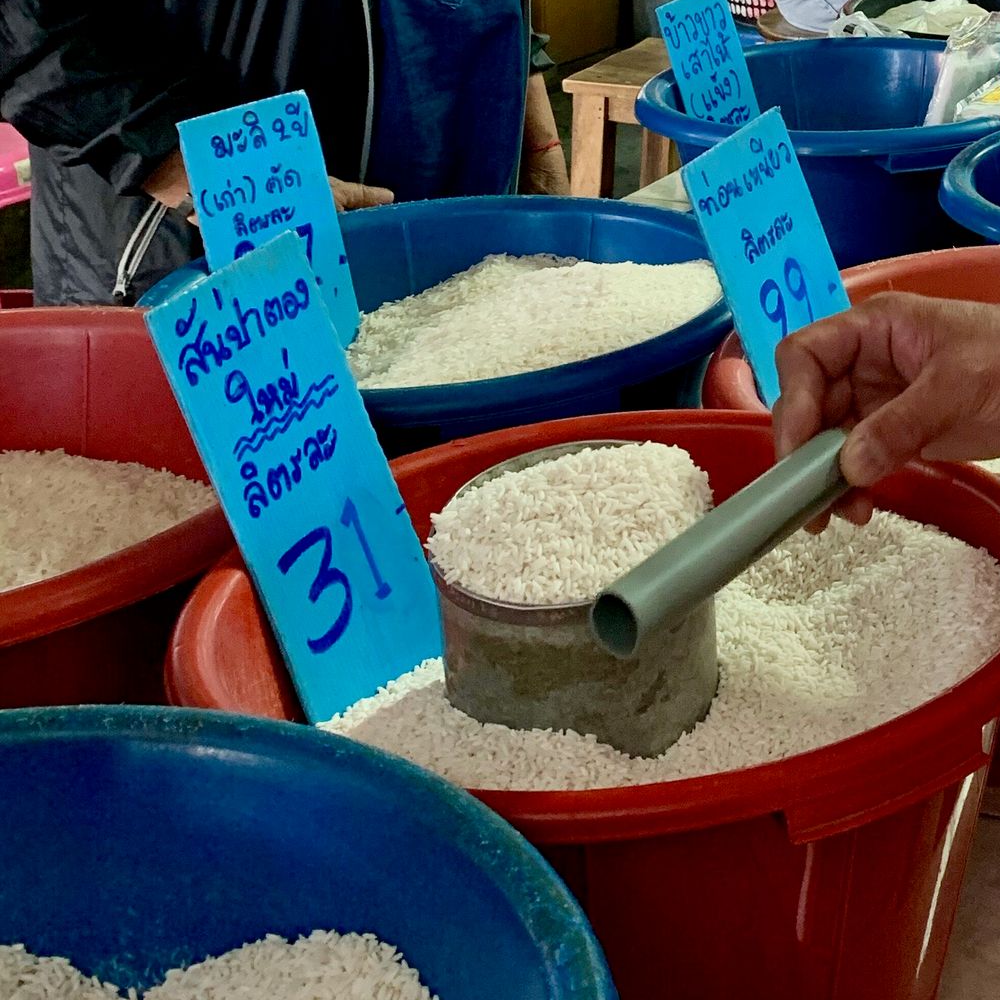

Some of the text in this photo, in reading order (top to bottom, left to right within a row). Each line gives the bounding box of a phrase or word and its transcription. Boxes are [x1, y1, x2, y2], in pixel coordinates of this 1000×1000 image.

[664, 2, 727, 50] ข้าวขาว
[211, 110, 267, 159] มะลิ
[200, 175, 256, 218] (เก่า)
[232, 206, 296, 237] ลิตรละ
[740, 212, 794, 265] ลิตรละ
[175, 277, 311, 387] สันป่าตอง
[224, 347, 301, 425] ใหม่
[240, 423, 339, 519] ลิตรละ
